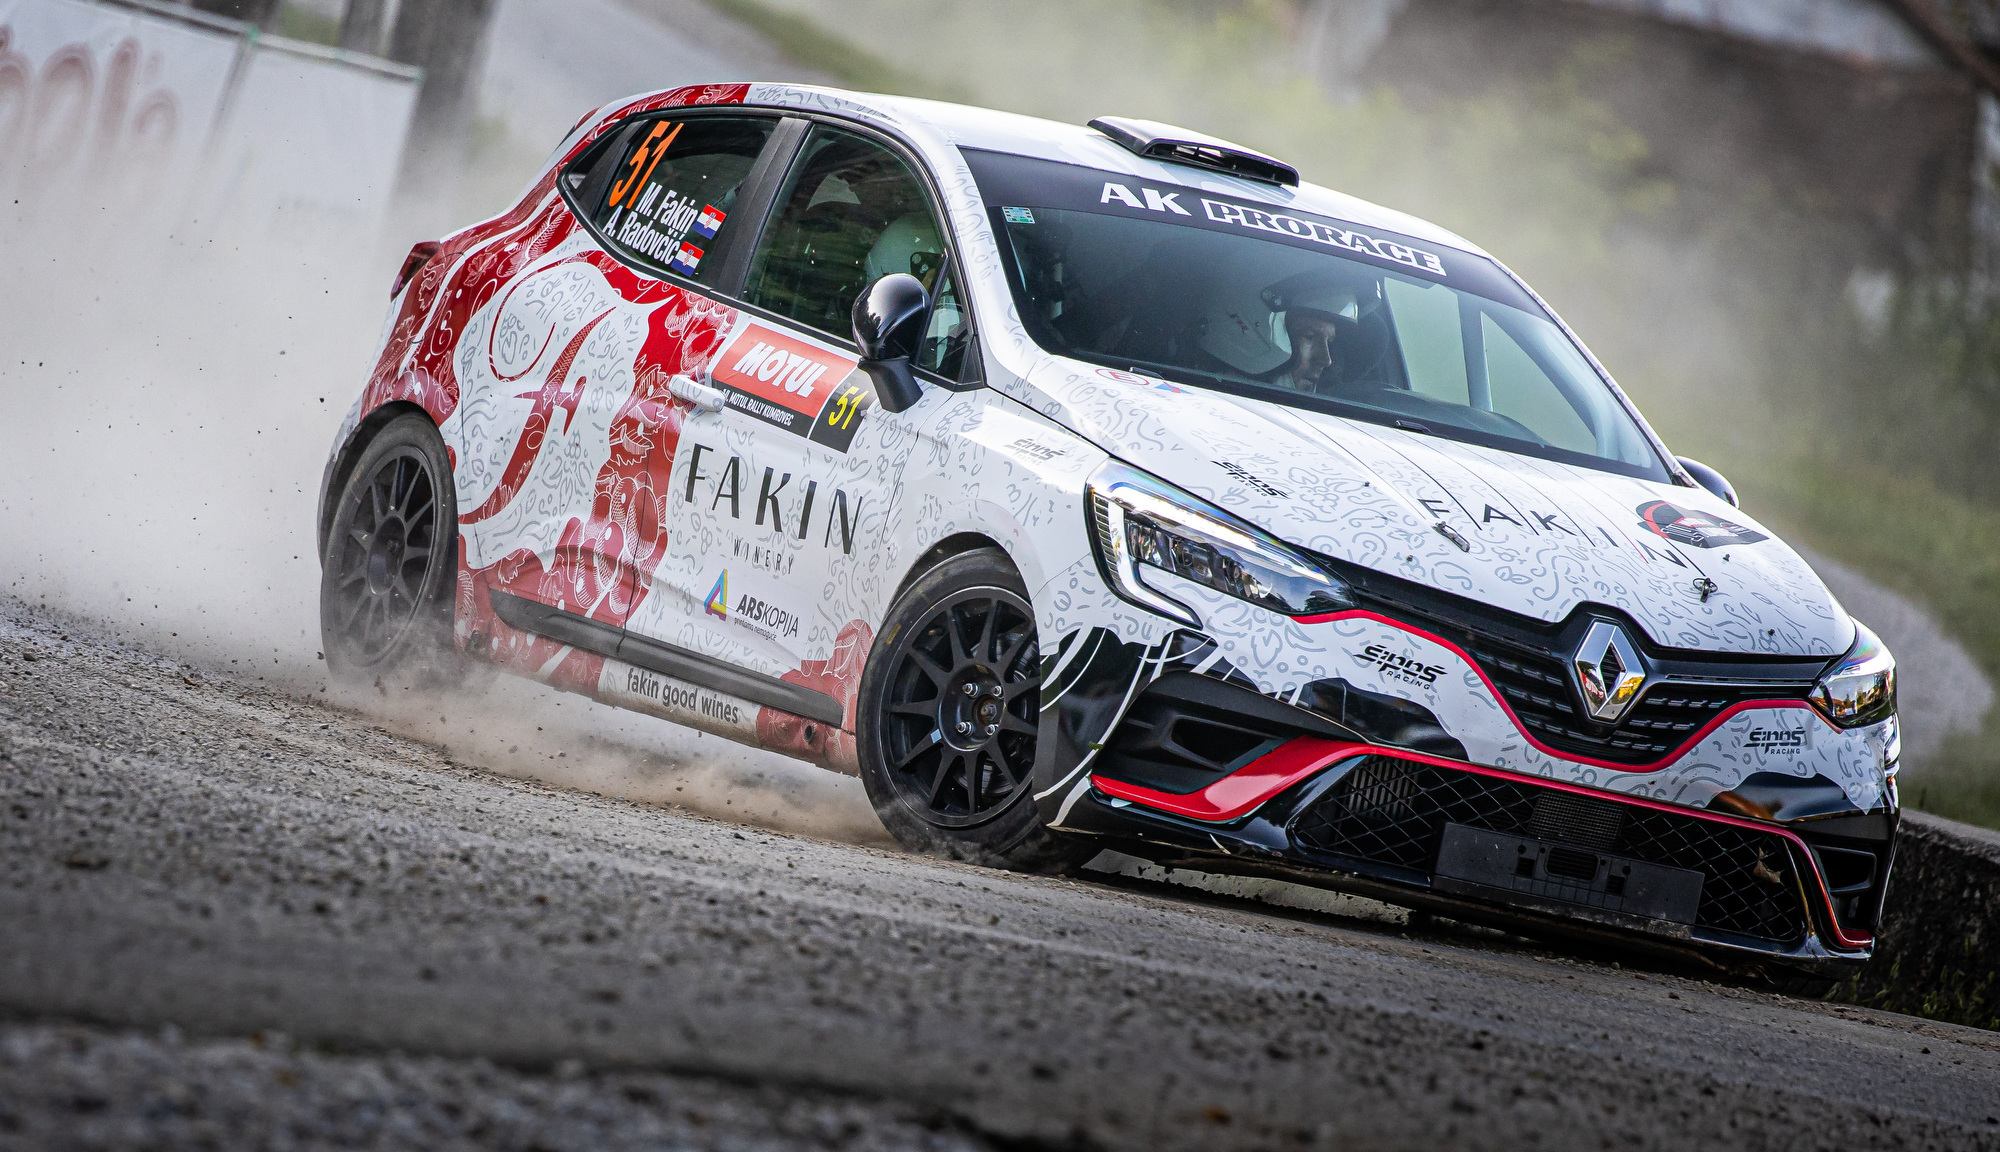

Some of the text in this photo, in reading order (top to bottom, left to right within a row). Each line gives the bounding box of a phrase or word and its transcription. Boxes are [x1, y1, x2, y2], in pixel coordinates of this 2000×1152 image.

[609, 120, 684, 209] 51
[602, 205, 686, 265] A. Radovčić
[635, 181, 699, 234] M. Fakin
[1100, 182, 1447, 276] AK PRORACE
[732, 341, 829, 398] MOTUL
[728, 391, 750, 410] MOTUL
[747, 398, 766, 415] RALLY
[828, 385, 869, 430] 51
[684, 443, 863, 555] FAKIN
[733, 538, 794, 575] WINERY
[735, 594, 799, 638] ARSKOPIJA
[627, 667, 739, 725] fakin good wines
[1387, 670, 1431, 690] RACING
